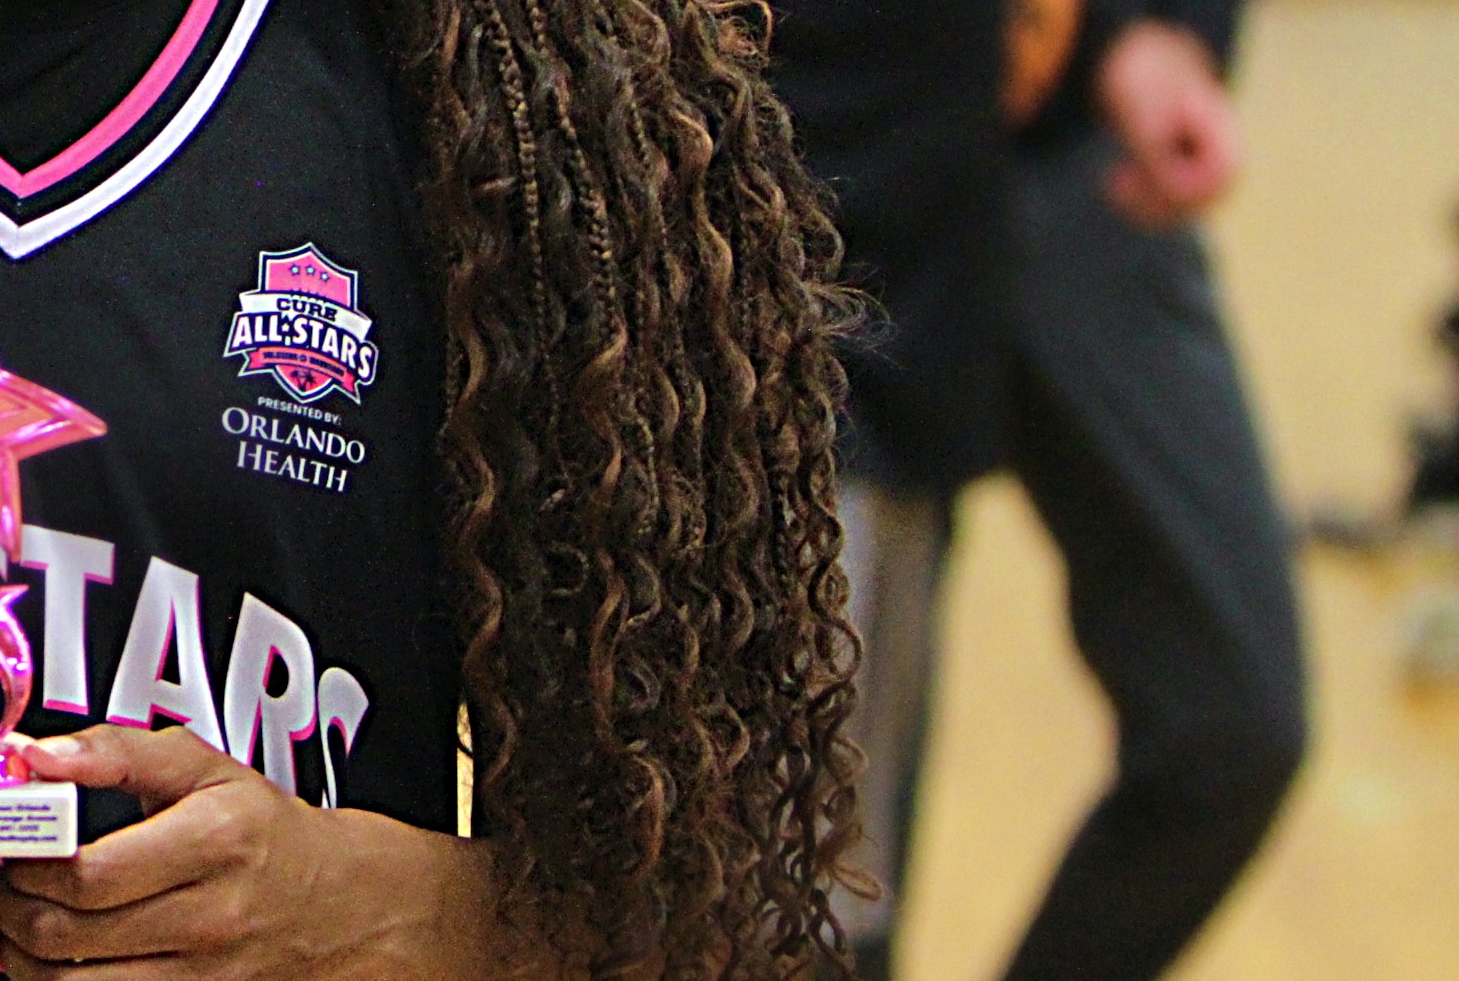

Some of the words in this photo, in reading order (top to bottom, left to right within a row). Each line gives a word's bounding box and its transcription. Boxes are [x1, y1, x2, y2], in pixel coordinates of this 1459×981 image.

[276, 297, 337, 321] CURE
[257, 396, 323, 420] PRESENTED
[222, 407, 365, 464] ORLANDO
[237, 441, 348, 492] HEALTH
